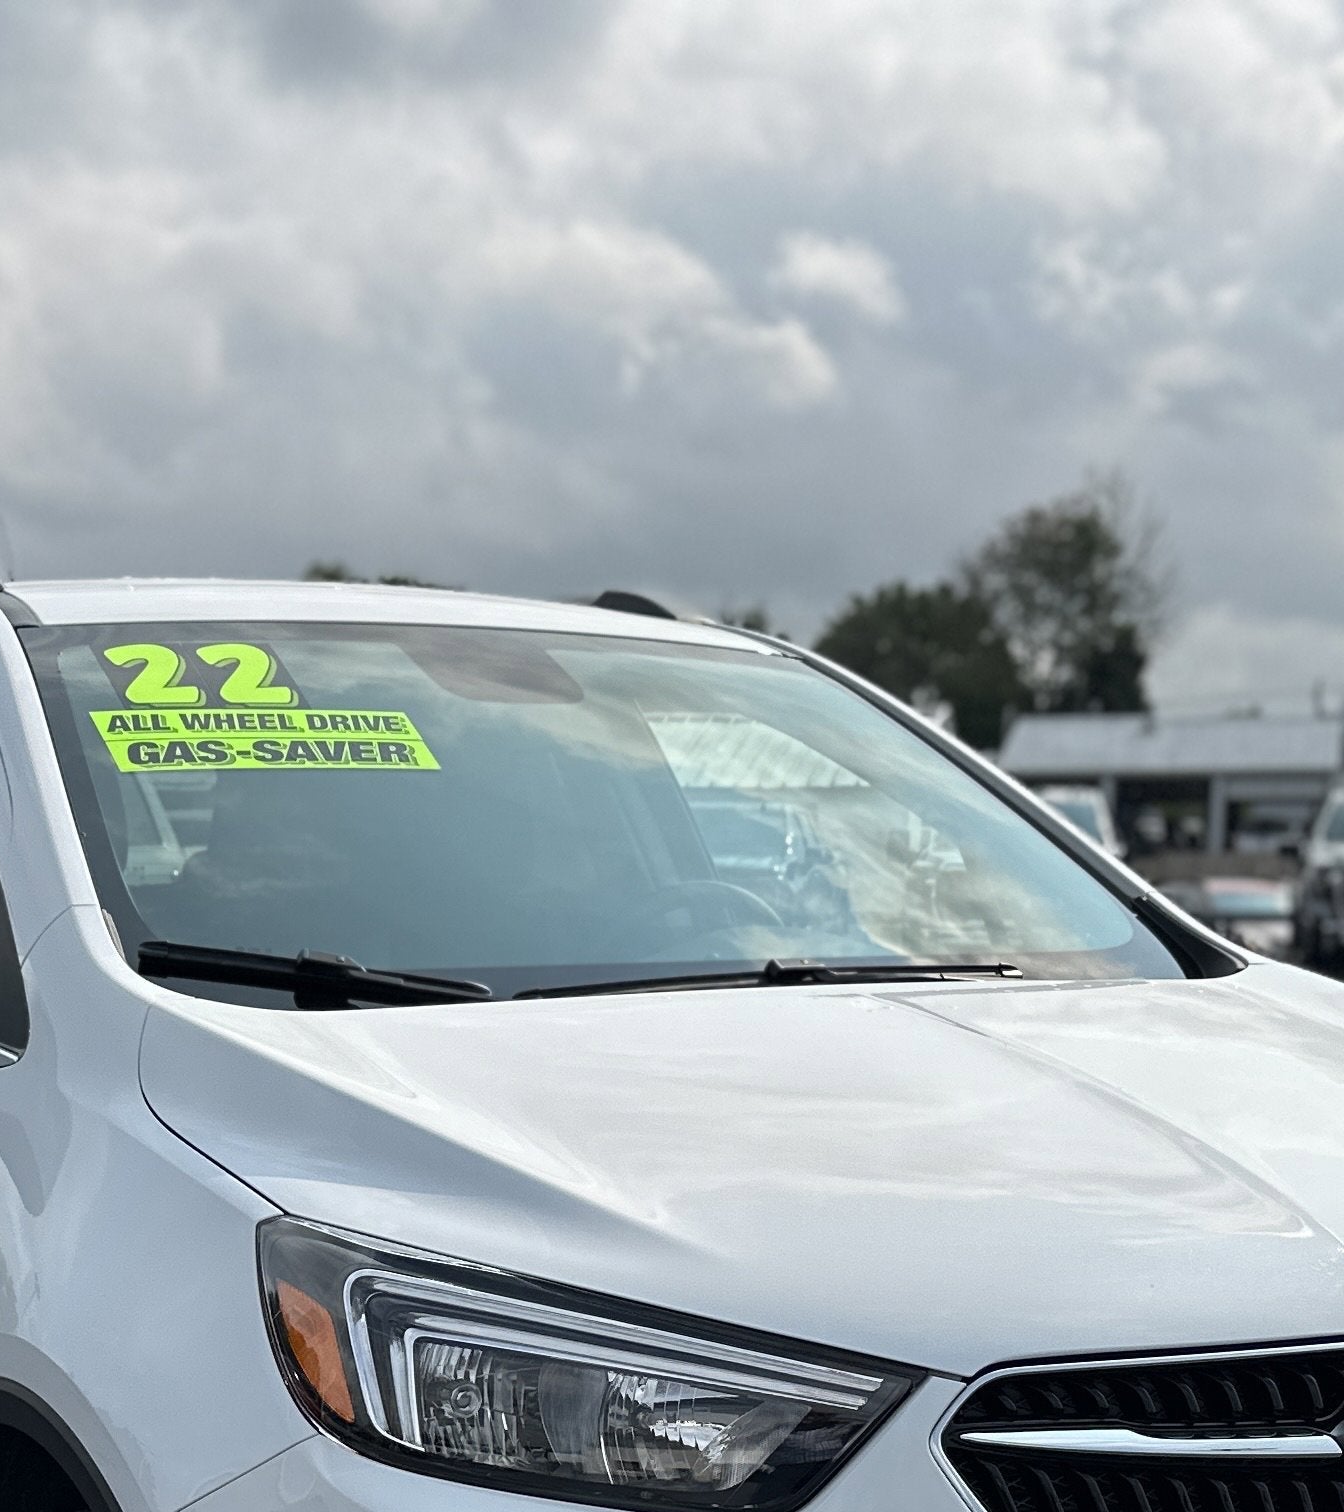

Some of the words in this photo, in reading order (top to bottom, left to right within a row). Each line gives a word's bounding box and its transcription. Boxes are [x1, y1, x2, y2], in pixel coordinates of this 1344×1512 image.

[103, 642, 297, 706] 22
[106, 713, 174, 735] ALL
[179, 712, 300, 734] WHEEL
[307, 712, 408, 735] DRIVE
[126, 739, 417, 767] GAS-SAVER
